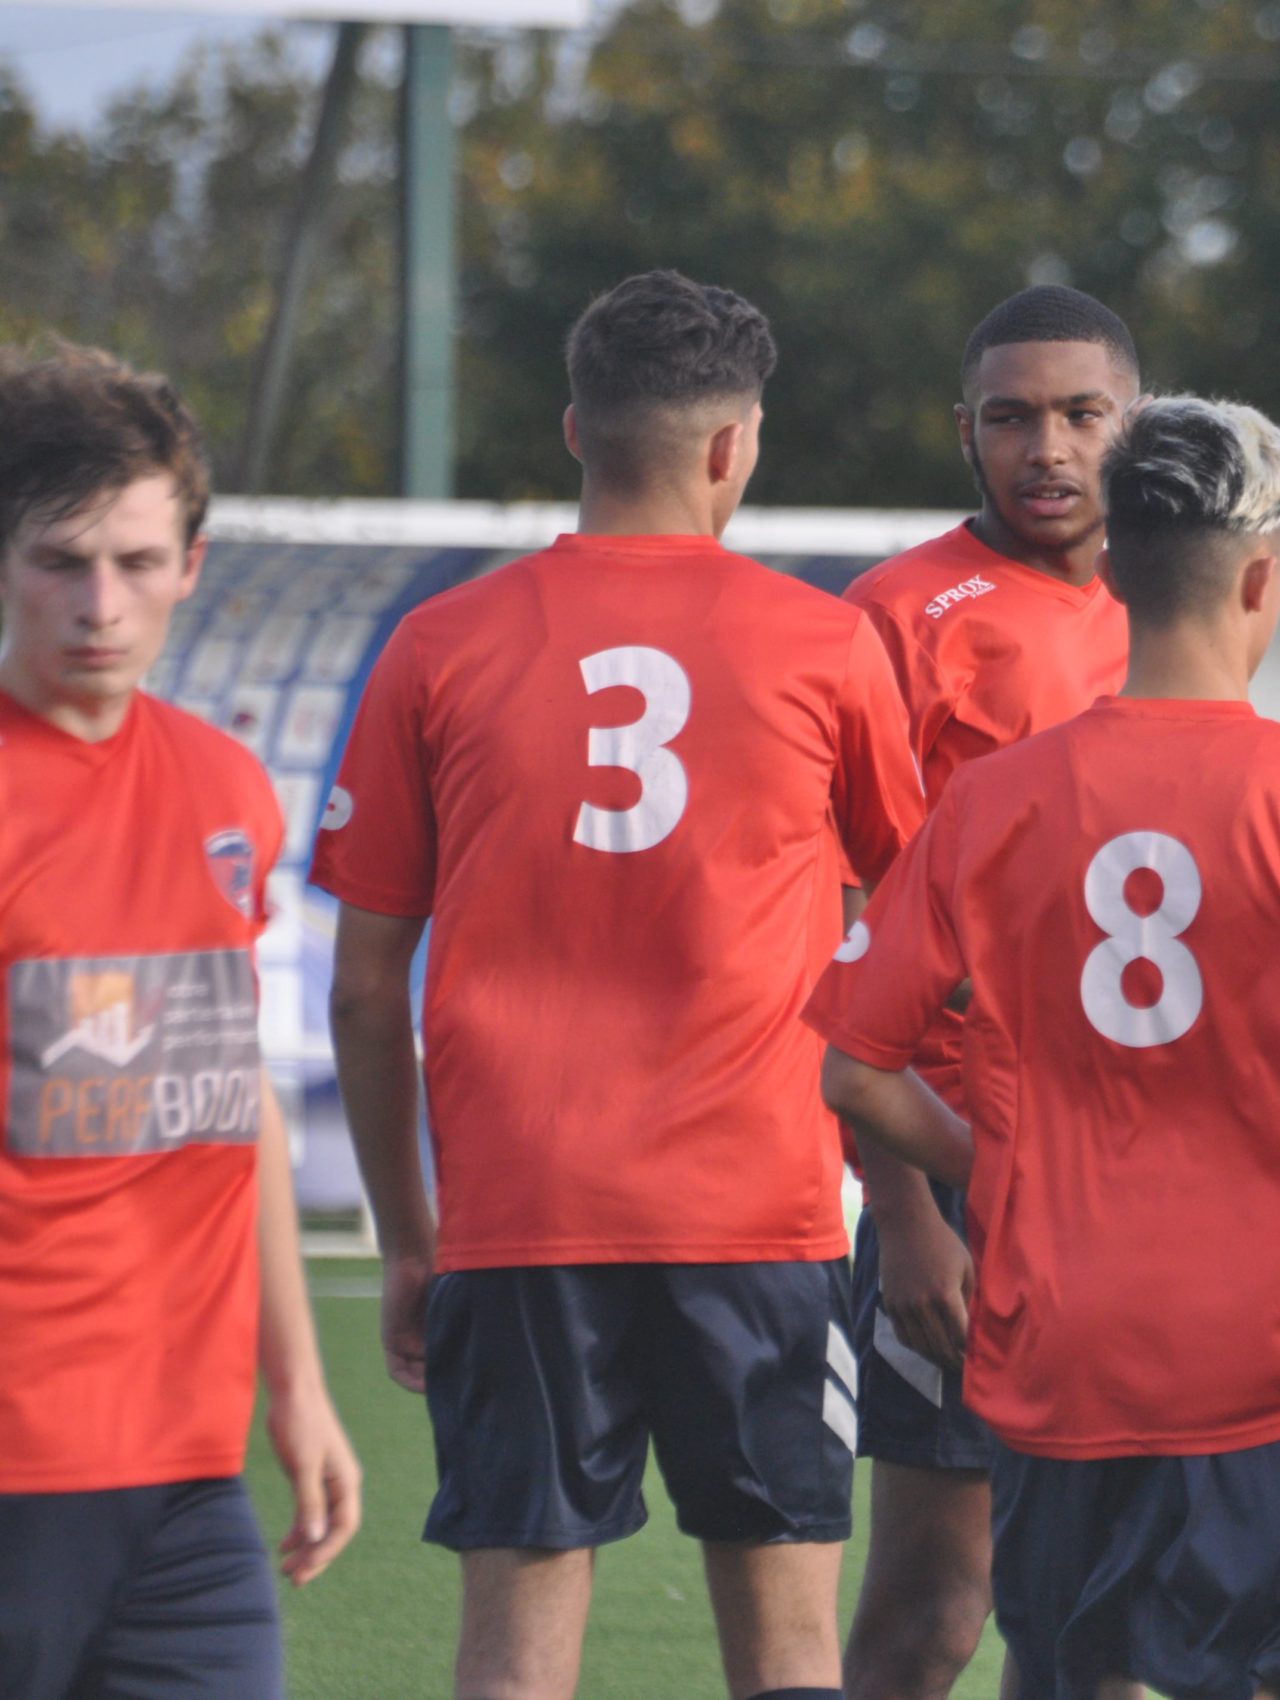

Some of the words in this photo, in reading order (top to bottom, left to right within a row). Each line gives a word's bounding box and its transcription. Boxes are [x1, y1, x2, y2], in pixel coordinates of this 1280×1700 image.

[925, 574, 990, 619] SPROX
[573, 645, 693, 853] 3
[1080, 831, 1203, 1048] 8
